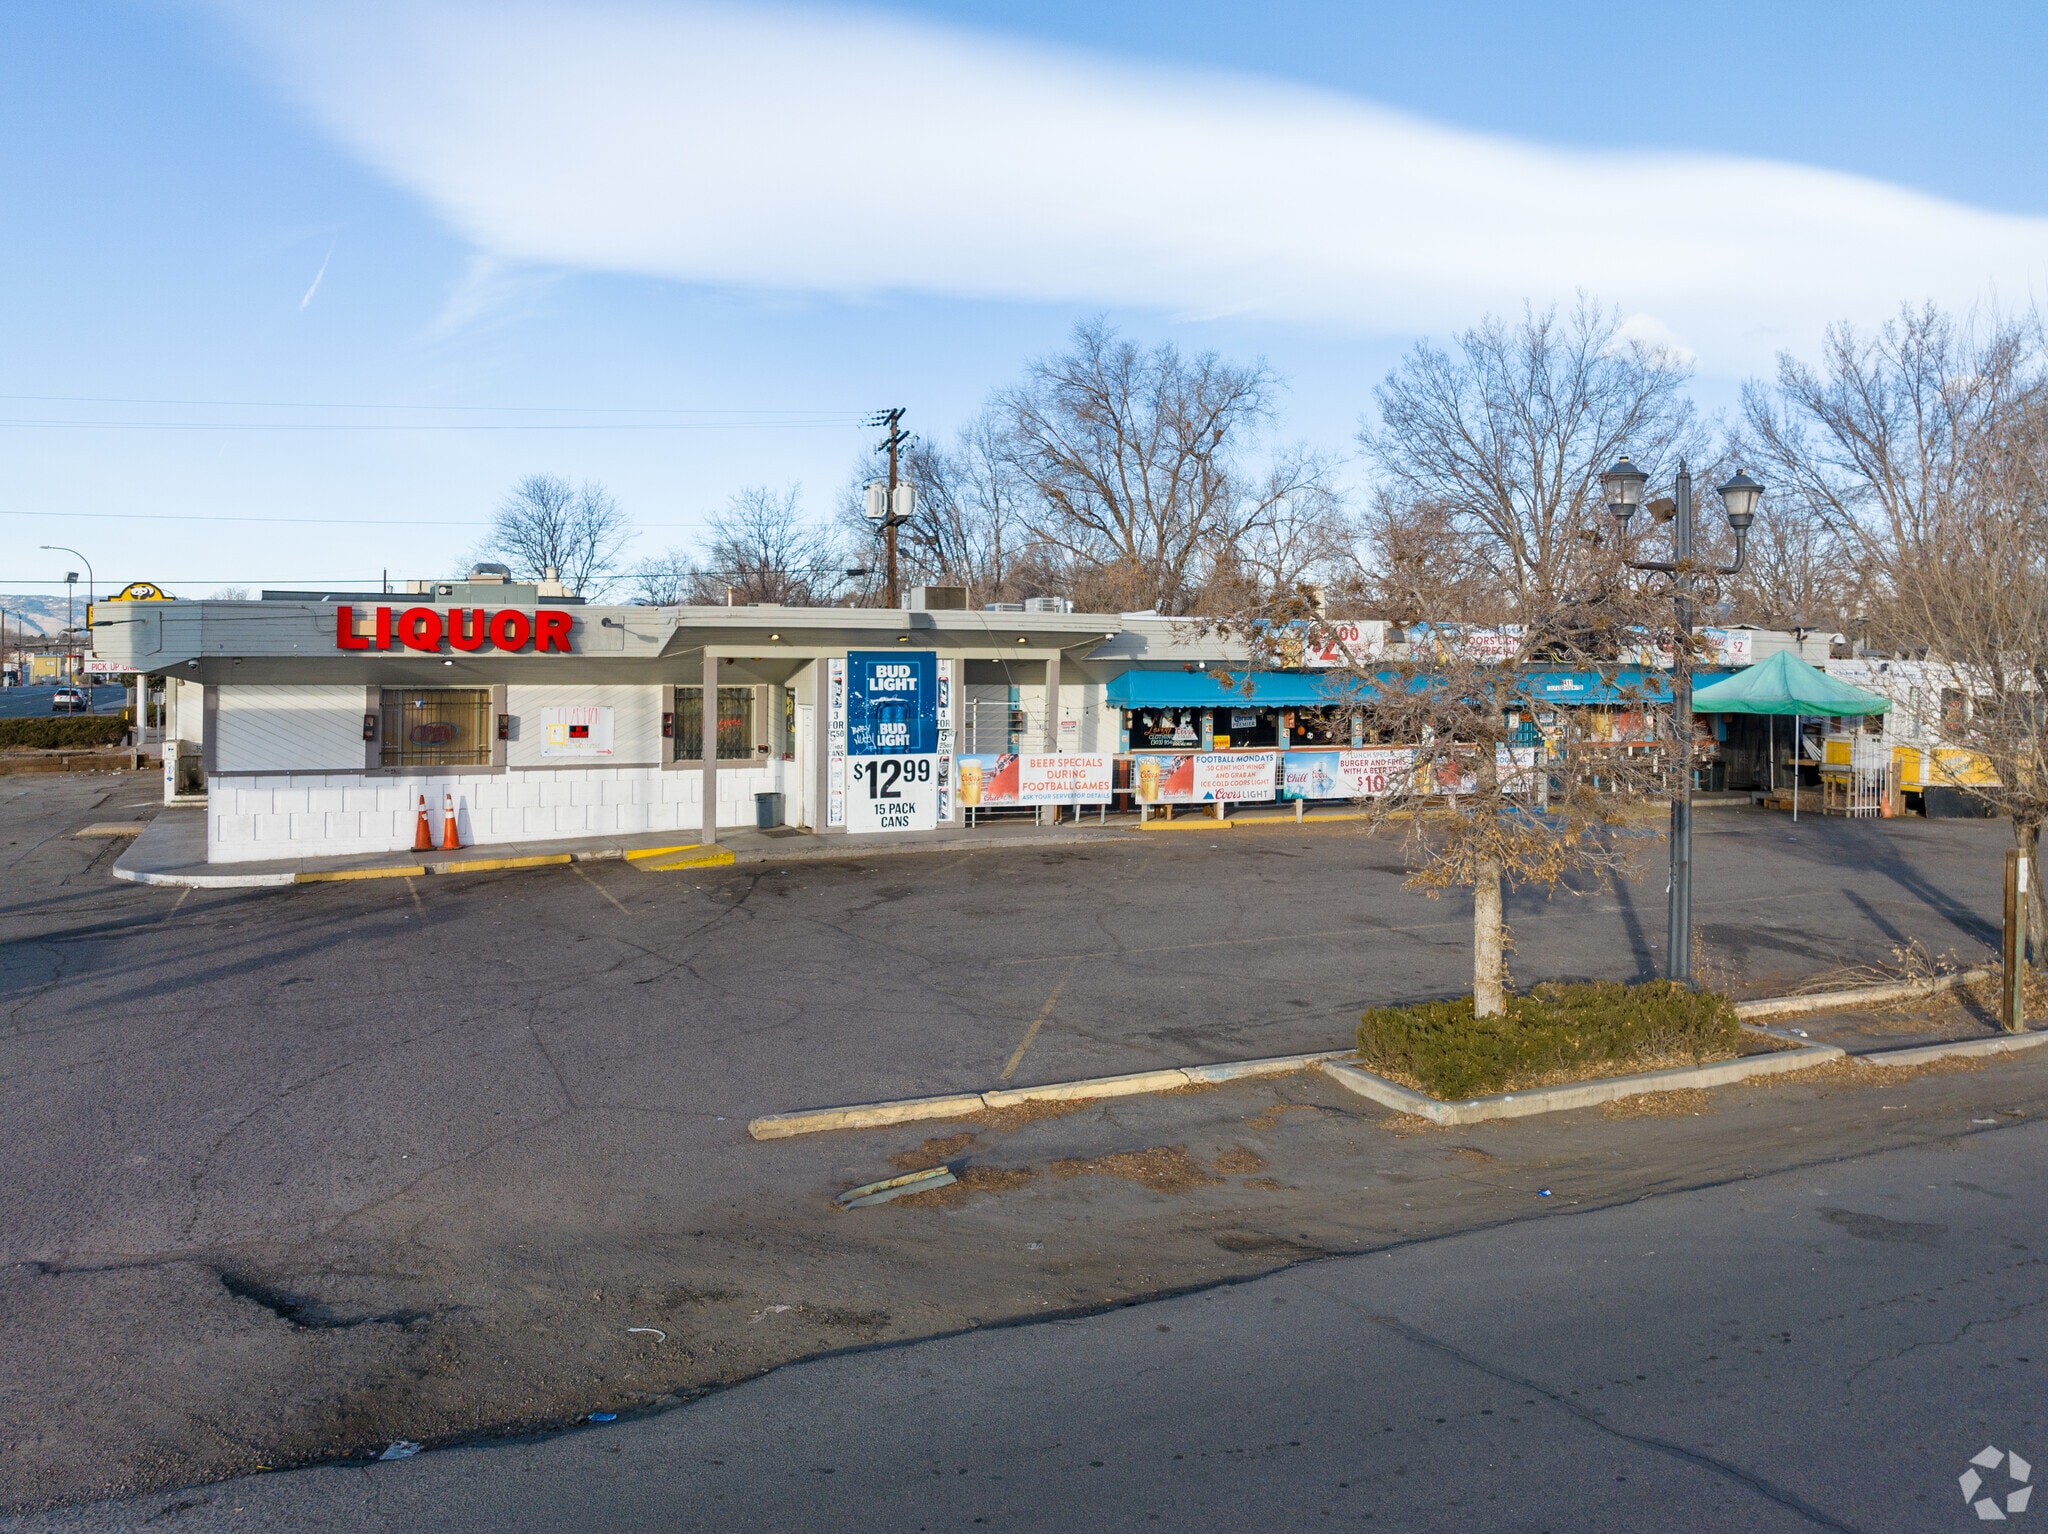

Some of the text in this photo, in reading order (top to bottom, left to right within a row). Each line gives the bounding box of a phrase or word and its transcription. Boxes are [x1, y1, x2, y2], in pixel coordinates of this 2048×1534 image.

[336, 605, 573, 652] LIQUOR
[1467, 636, 1495, 645] OORS
[1733, 641, 1743, 653] $2
[91, 663, 107, 671] PICK
[110, 663, 120, 671] UP
[875, 664, 911, 678] BUD
[869, 677, 917, 692] LIGHT
[833, 711, 839, 720] 3
[940, 710, 946, 718] 4
[879, 723, 907, 734] BUD
[936, 719, 951, 728] FOR
[876, 734, 911, 747] LIGHT
[1030, 758, 1103, 768] BEER SPECIALS
[1236, 754, 1274, 762] MONDAYS
[1047, 770, 1086, 779] DURING
[1286, 773, 1308, 783] Chill
[1022, 781, 1110, 791] FOOTBALL GAMES
[1357, 775, 1385, 792] $10
[1215, 788, 1268, 799] Coors LIGHT
[874, 802, 916, 816] 15 PACK
[881, 816, 909, 828] CANS
